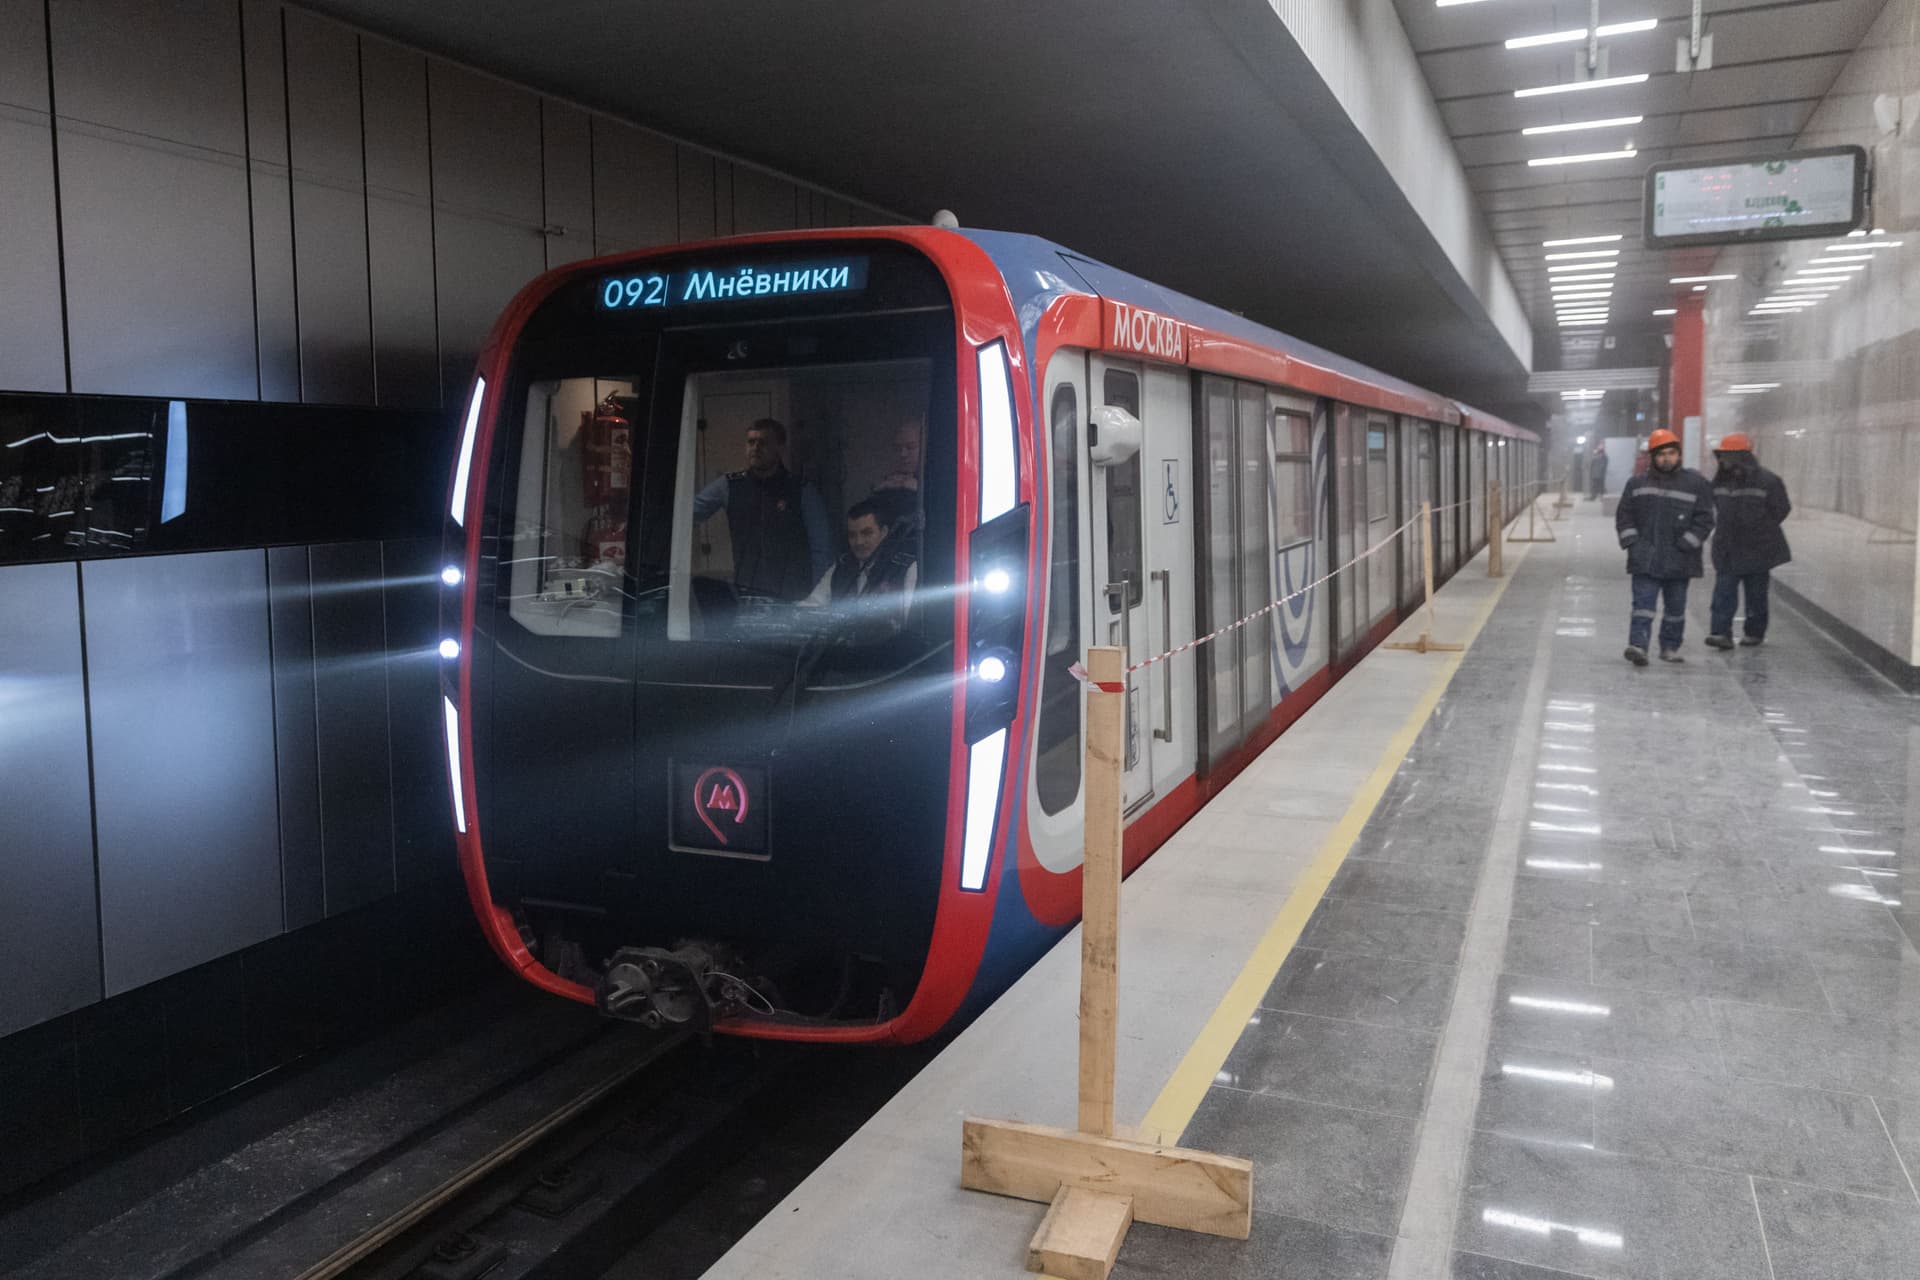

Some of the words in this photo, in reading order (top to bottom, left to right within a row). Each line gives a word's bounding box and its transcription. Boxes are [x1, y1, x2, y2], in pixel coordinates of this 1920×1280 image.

[604, 276, 663, 308] 092
[683, 266, 849, 300] Мнёвники
[1113, 305, 1182, 360] МОСКВА
